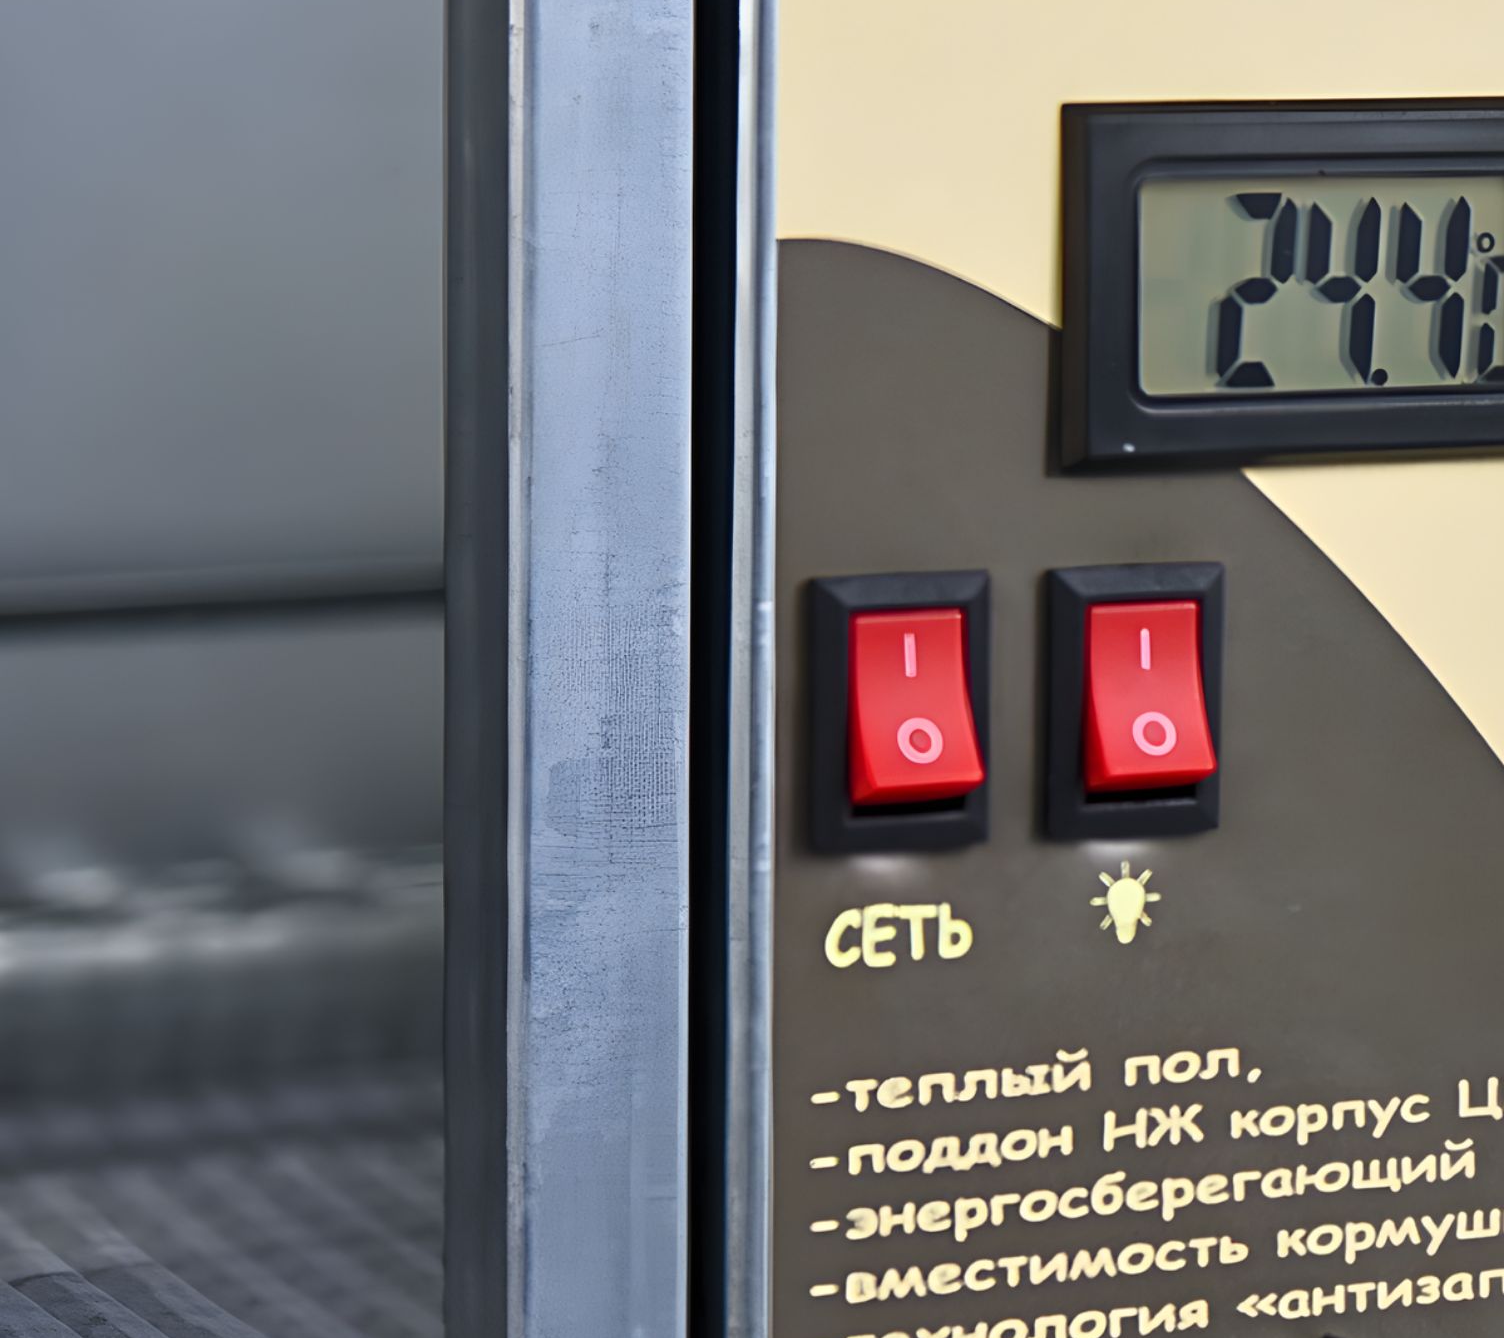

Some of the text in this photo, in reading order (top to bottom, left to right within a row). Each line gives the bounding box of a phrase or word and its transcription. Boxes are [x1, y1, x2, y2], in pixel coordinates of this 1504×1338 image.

[824, 901, 973, 969] СЕТЬ
[1124, 1047, 1262, 1091] пол,
[1102, 1104, 1204, 1152] НЖ
[1230, 1092, 1431, 1157] корпус
